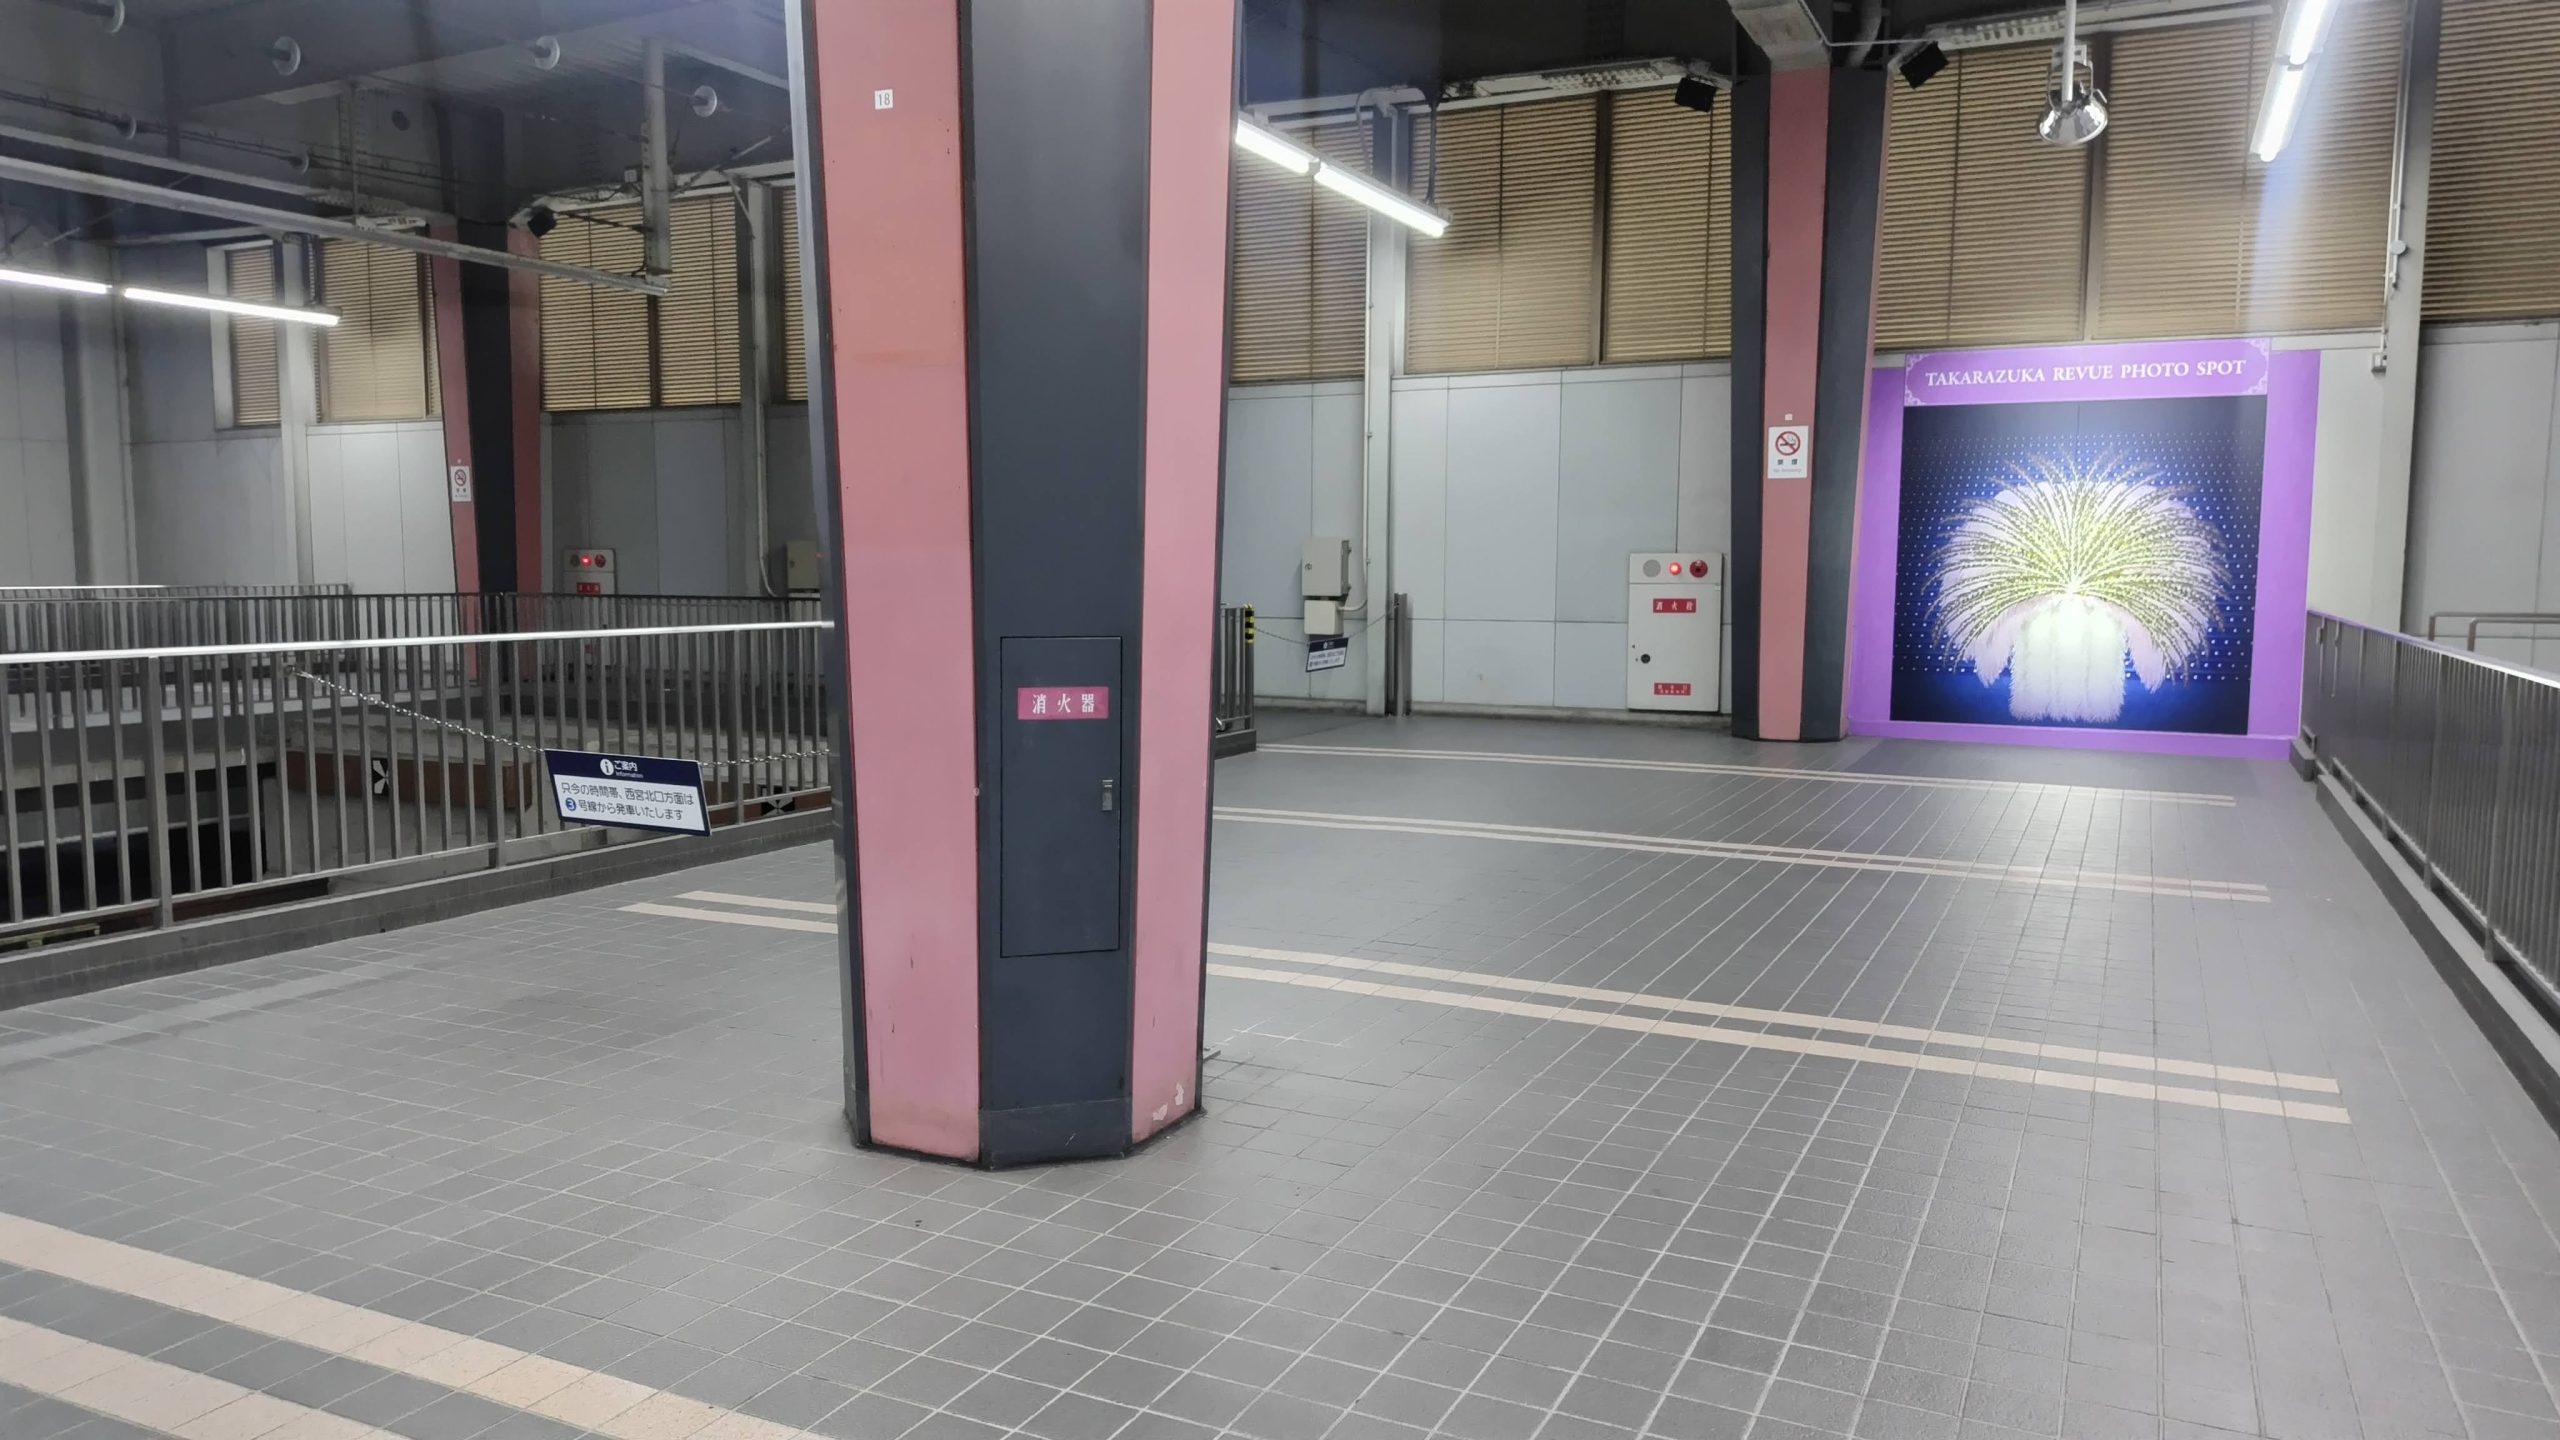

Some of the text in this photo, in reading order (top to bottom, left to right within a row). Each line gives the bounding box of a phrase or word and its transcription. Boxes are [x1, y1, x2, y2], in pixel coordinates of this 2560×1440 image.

[878, 93, 890, 106] 18
[1925, 359, 2247, 387] TAKARAZUKA REVUE PHOTO SPOT
[1032, 693, 1094, 714] 消火器
